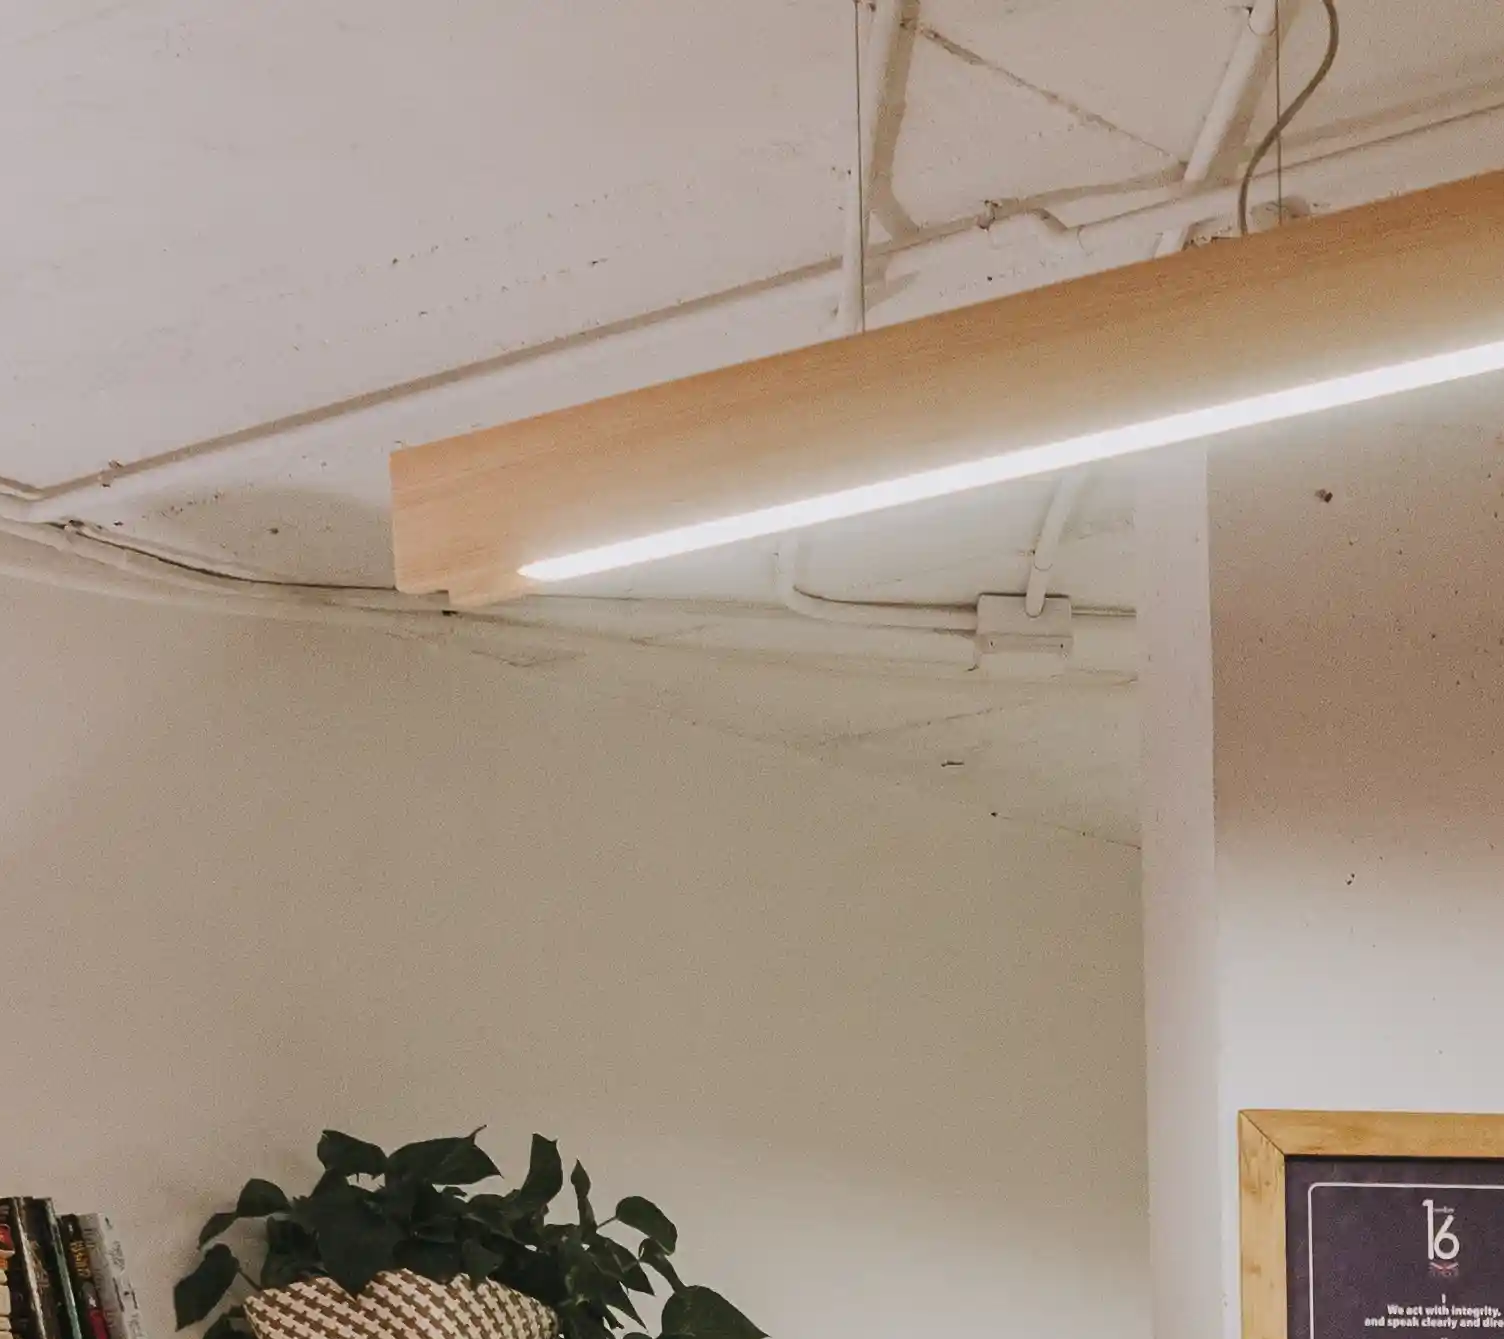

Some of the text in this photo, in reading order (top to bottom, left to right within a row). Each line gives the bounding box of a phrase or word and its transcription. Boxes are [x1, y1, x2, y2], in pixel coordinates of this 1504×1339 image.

[1422, 1199, 1460, 1260] 16
[1387, 1305, 1502, 1318] We act with integrity,
[1364, 1318, 1385, 1326] and
[1387, 1318, 1419, 1329] speak
[1421, 1318, 1458, 1329] clearly
[1459, 1318, 1480, 1328] and
